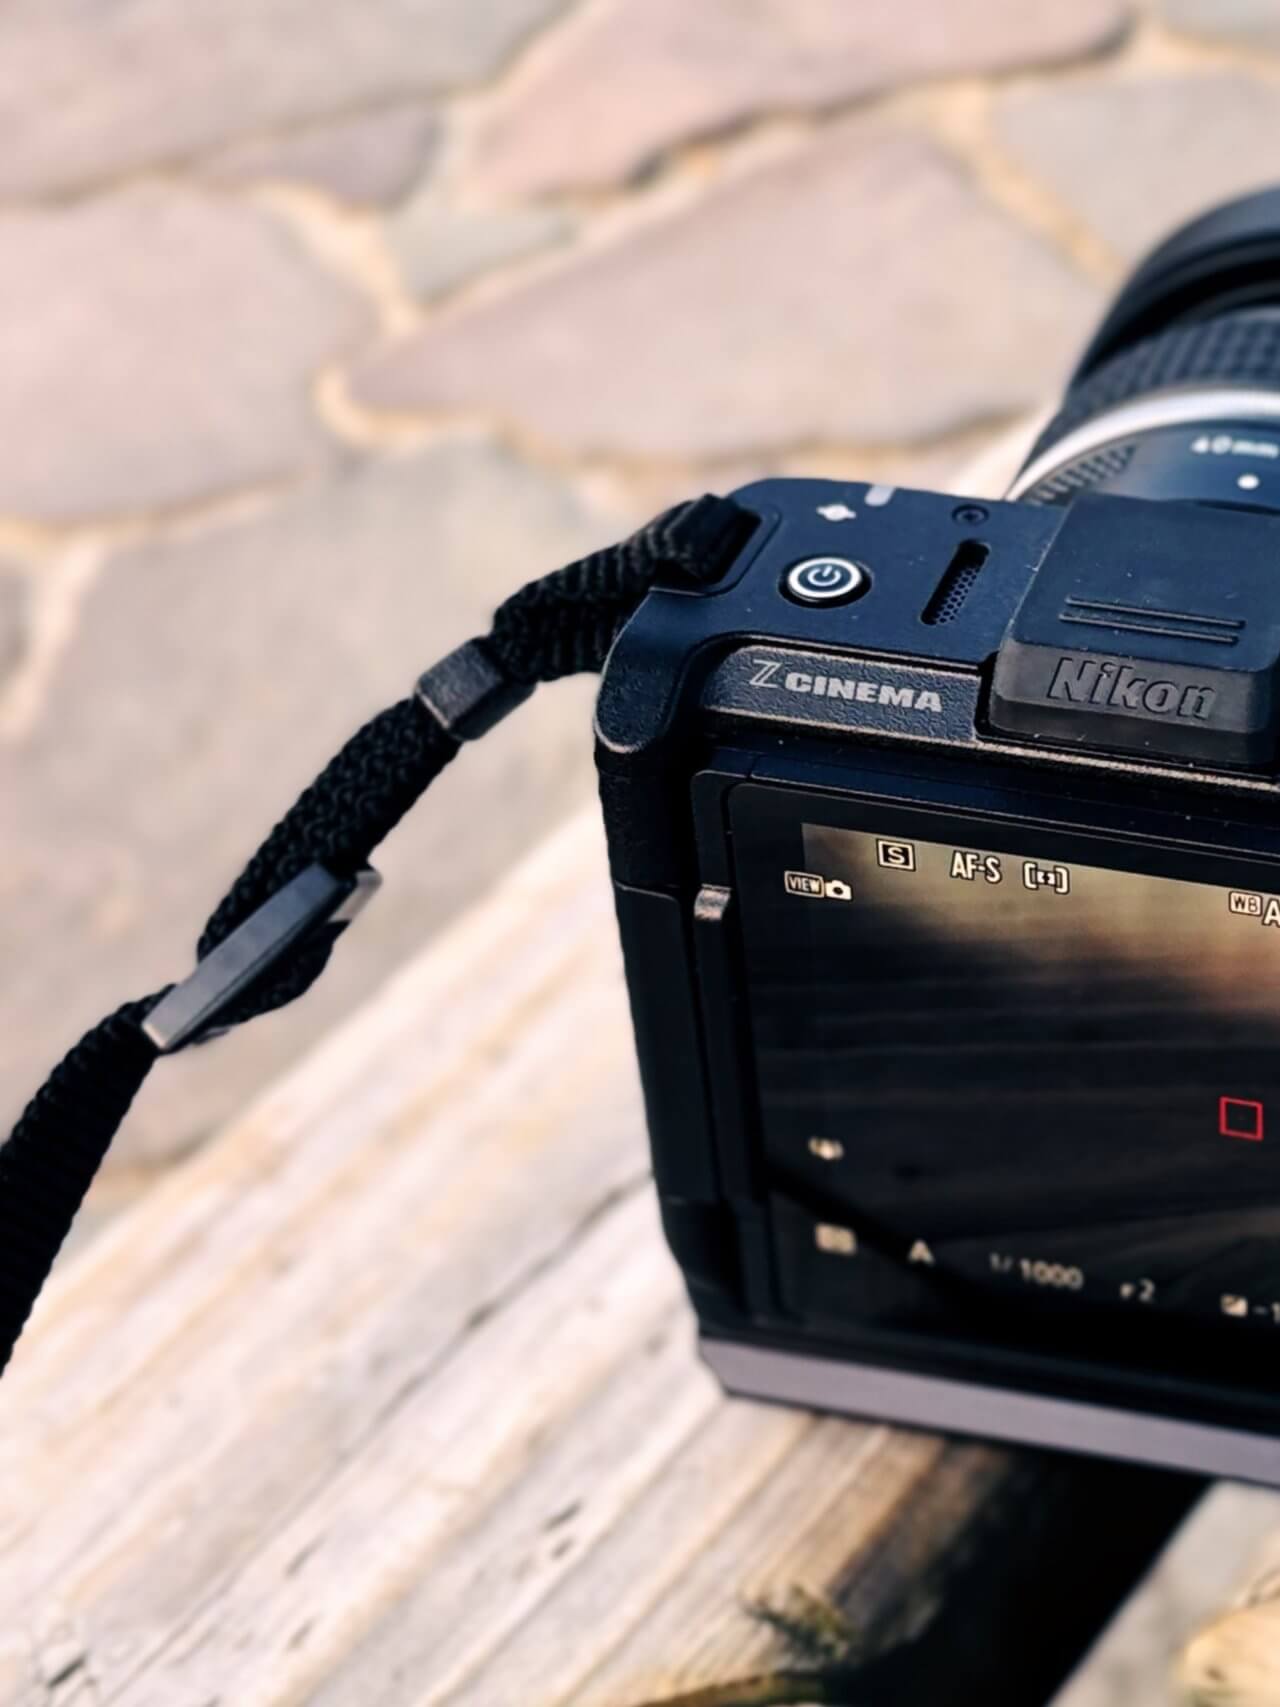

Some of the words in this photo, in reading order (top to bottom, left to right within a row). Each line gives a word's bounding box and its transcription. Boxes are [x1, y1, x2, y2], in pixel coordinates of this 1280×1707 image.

[784, 672, 943, 713] CINEMA
[1047, 655, 1218, 722] Nikon
[950, 850, 1002, 884] AF-S
[788, 874, 823, 895] VIEW
[1231, 893, 1260, 913] WB
[908, 1239, 934, 1264] A
